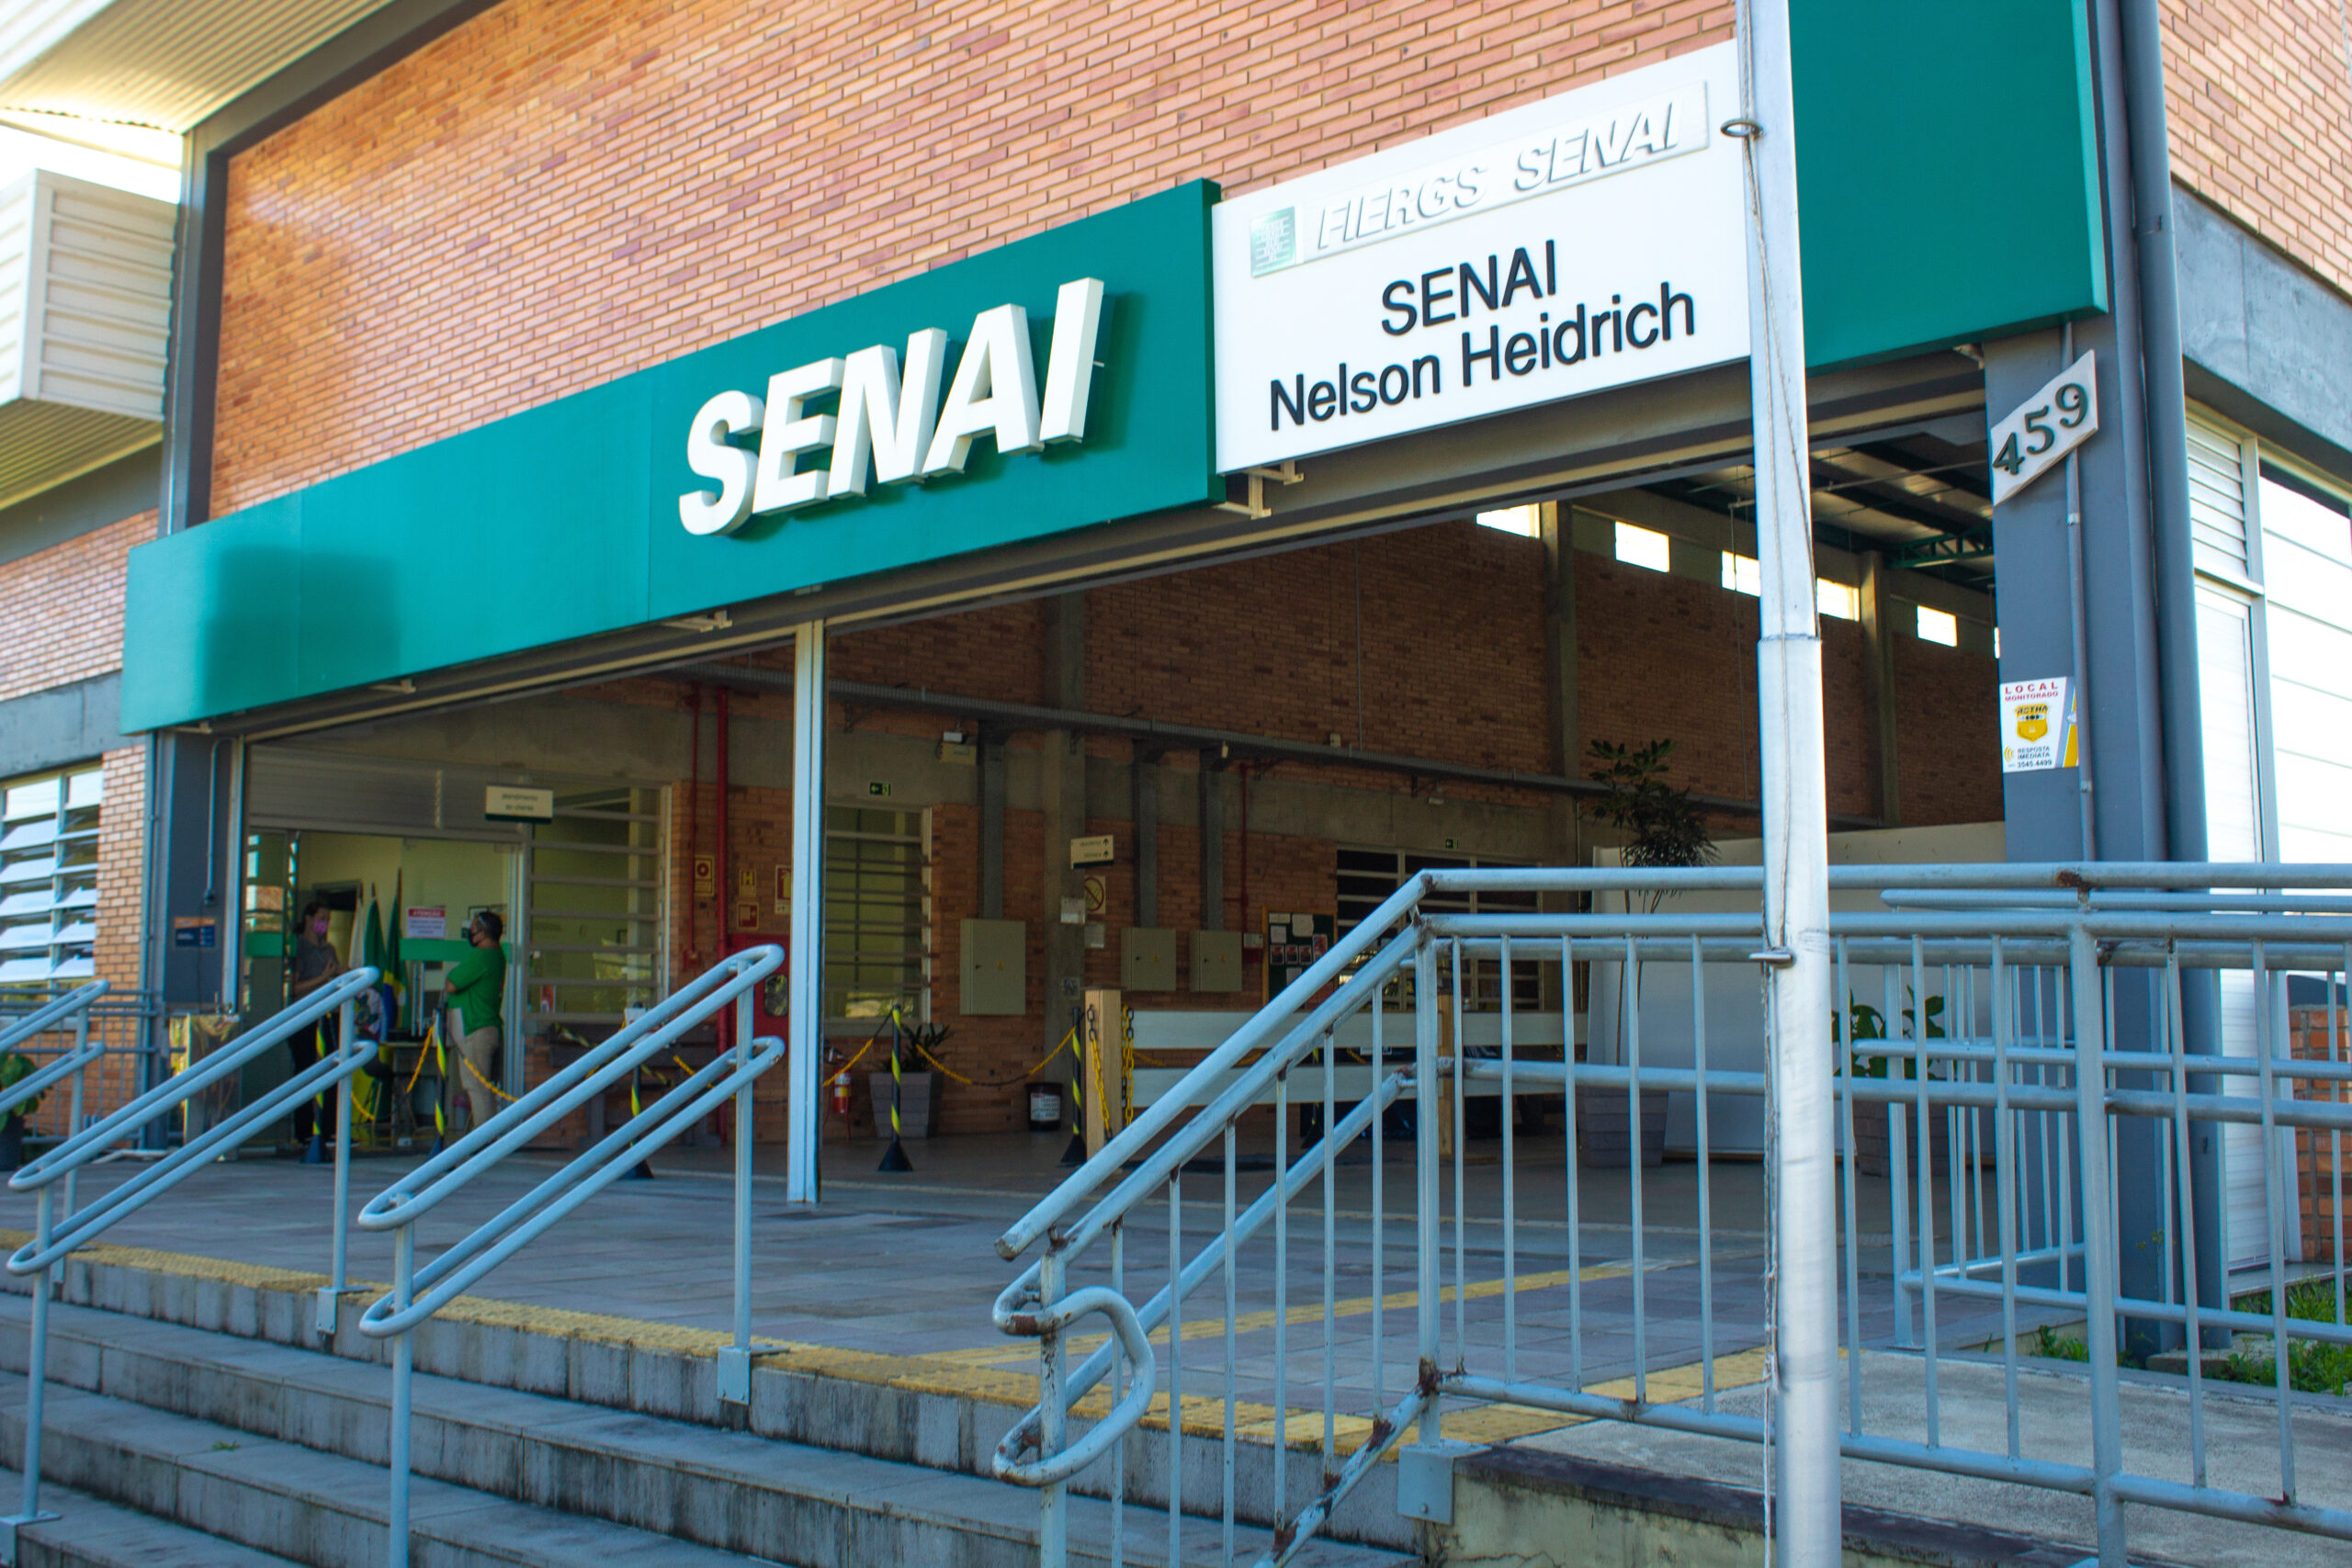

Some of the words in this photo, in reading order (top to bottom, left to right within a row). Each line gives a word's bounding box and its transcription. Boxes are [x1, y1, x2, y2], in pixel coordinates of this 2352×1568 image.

[1317, 165, 1490, 250] FIERGS
[1514, 96, 1682, 191] SENAI
[1381, 238, 1556, 336] SENAI
[1270, 353, 1441, 432] Nelson
[1461, 280, 1695, 388] Heidrich
[679, 276, 1104, 536] SENAI
[1992, 382, 2089, 476] 459
[2005, 682, 2058, 694] LOCAL
[2005, 691, 2058, 702] MONITORADO
[2017, 745, 2051, 755] RESPOSTA
[2017, 751, 2051, 760] IMEDIATA
